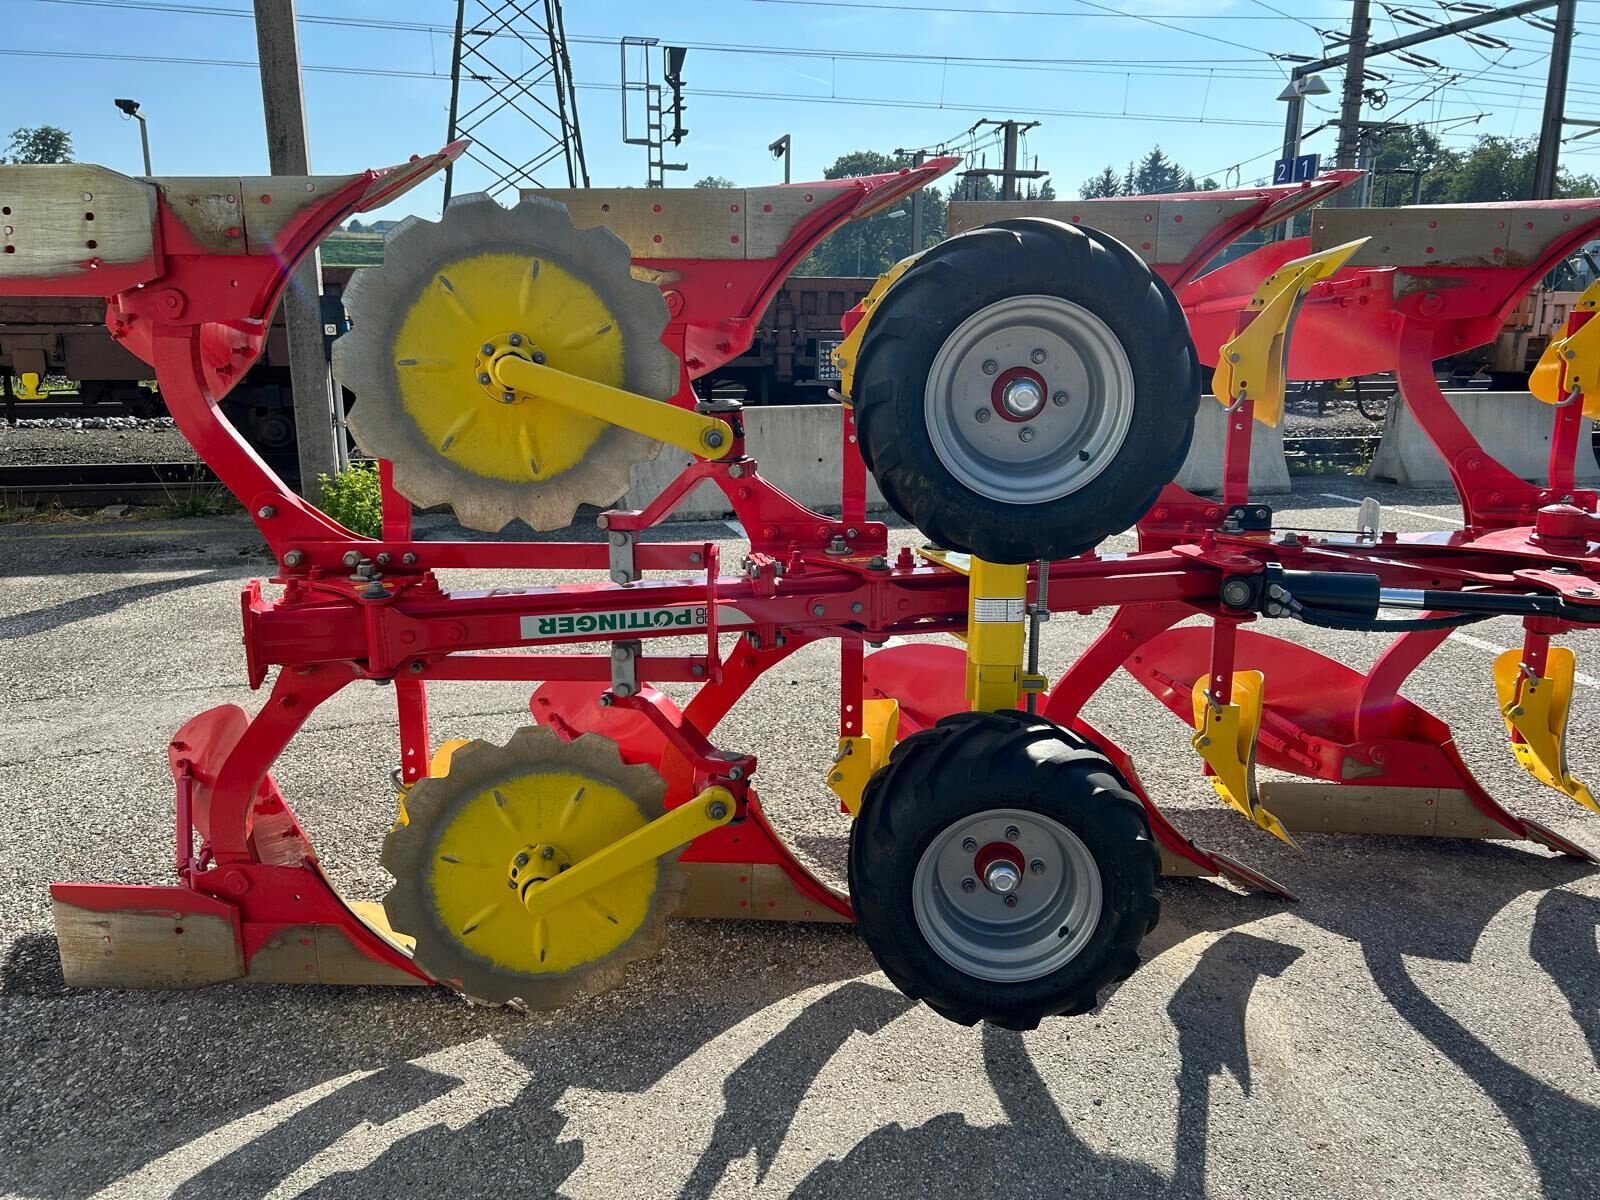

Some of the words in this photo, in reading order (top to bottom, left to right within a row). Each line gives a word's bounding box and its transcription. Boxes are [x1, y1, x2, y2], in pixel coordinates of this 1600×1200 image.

[1277, 163, 1286, 181] 2
[1302, 159, 1308, 177] 1
[538, 608, 692, 634] PÖTTINGER
